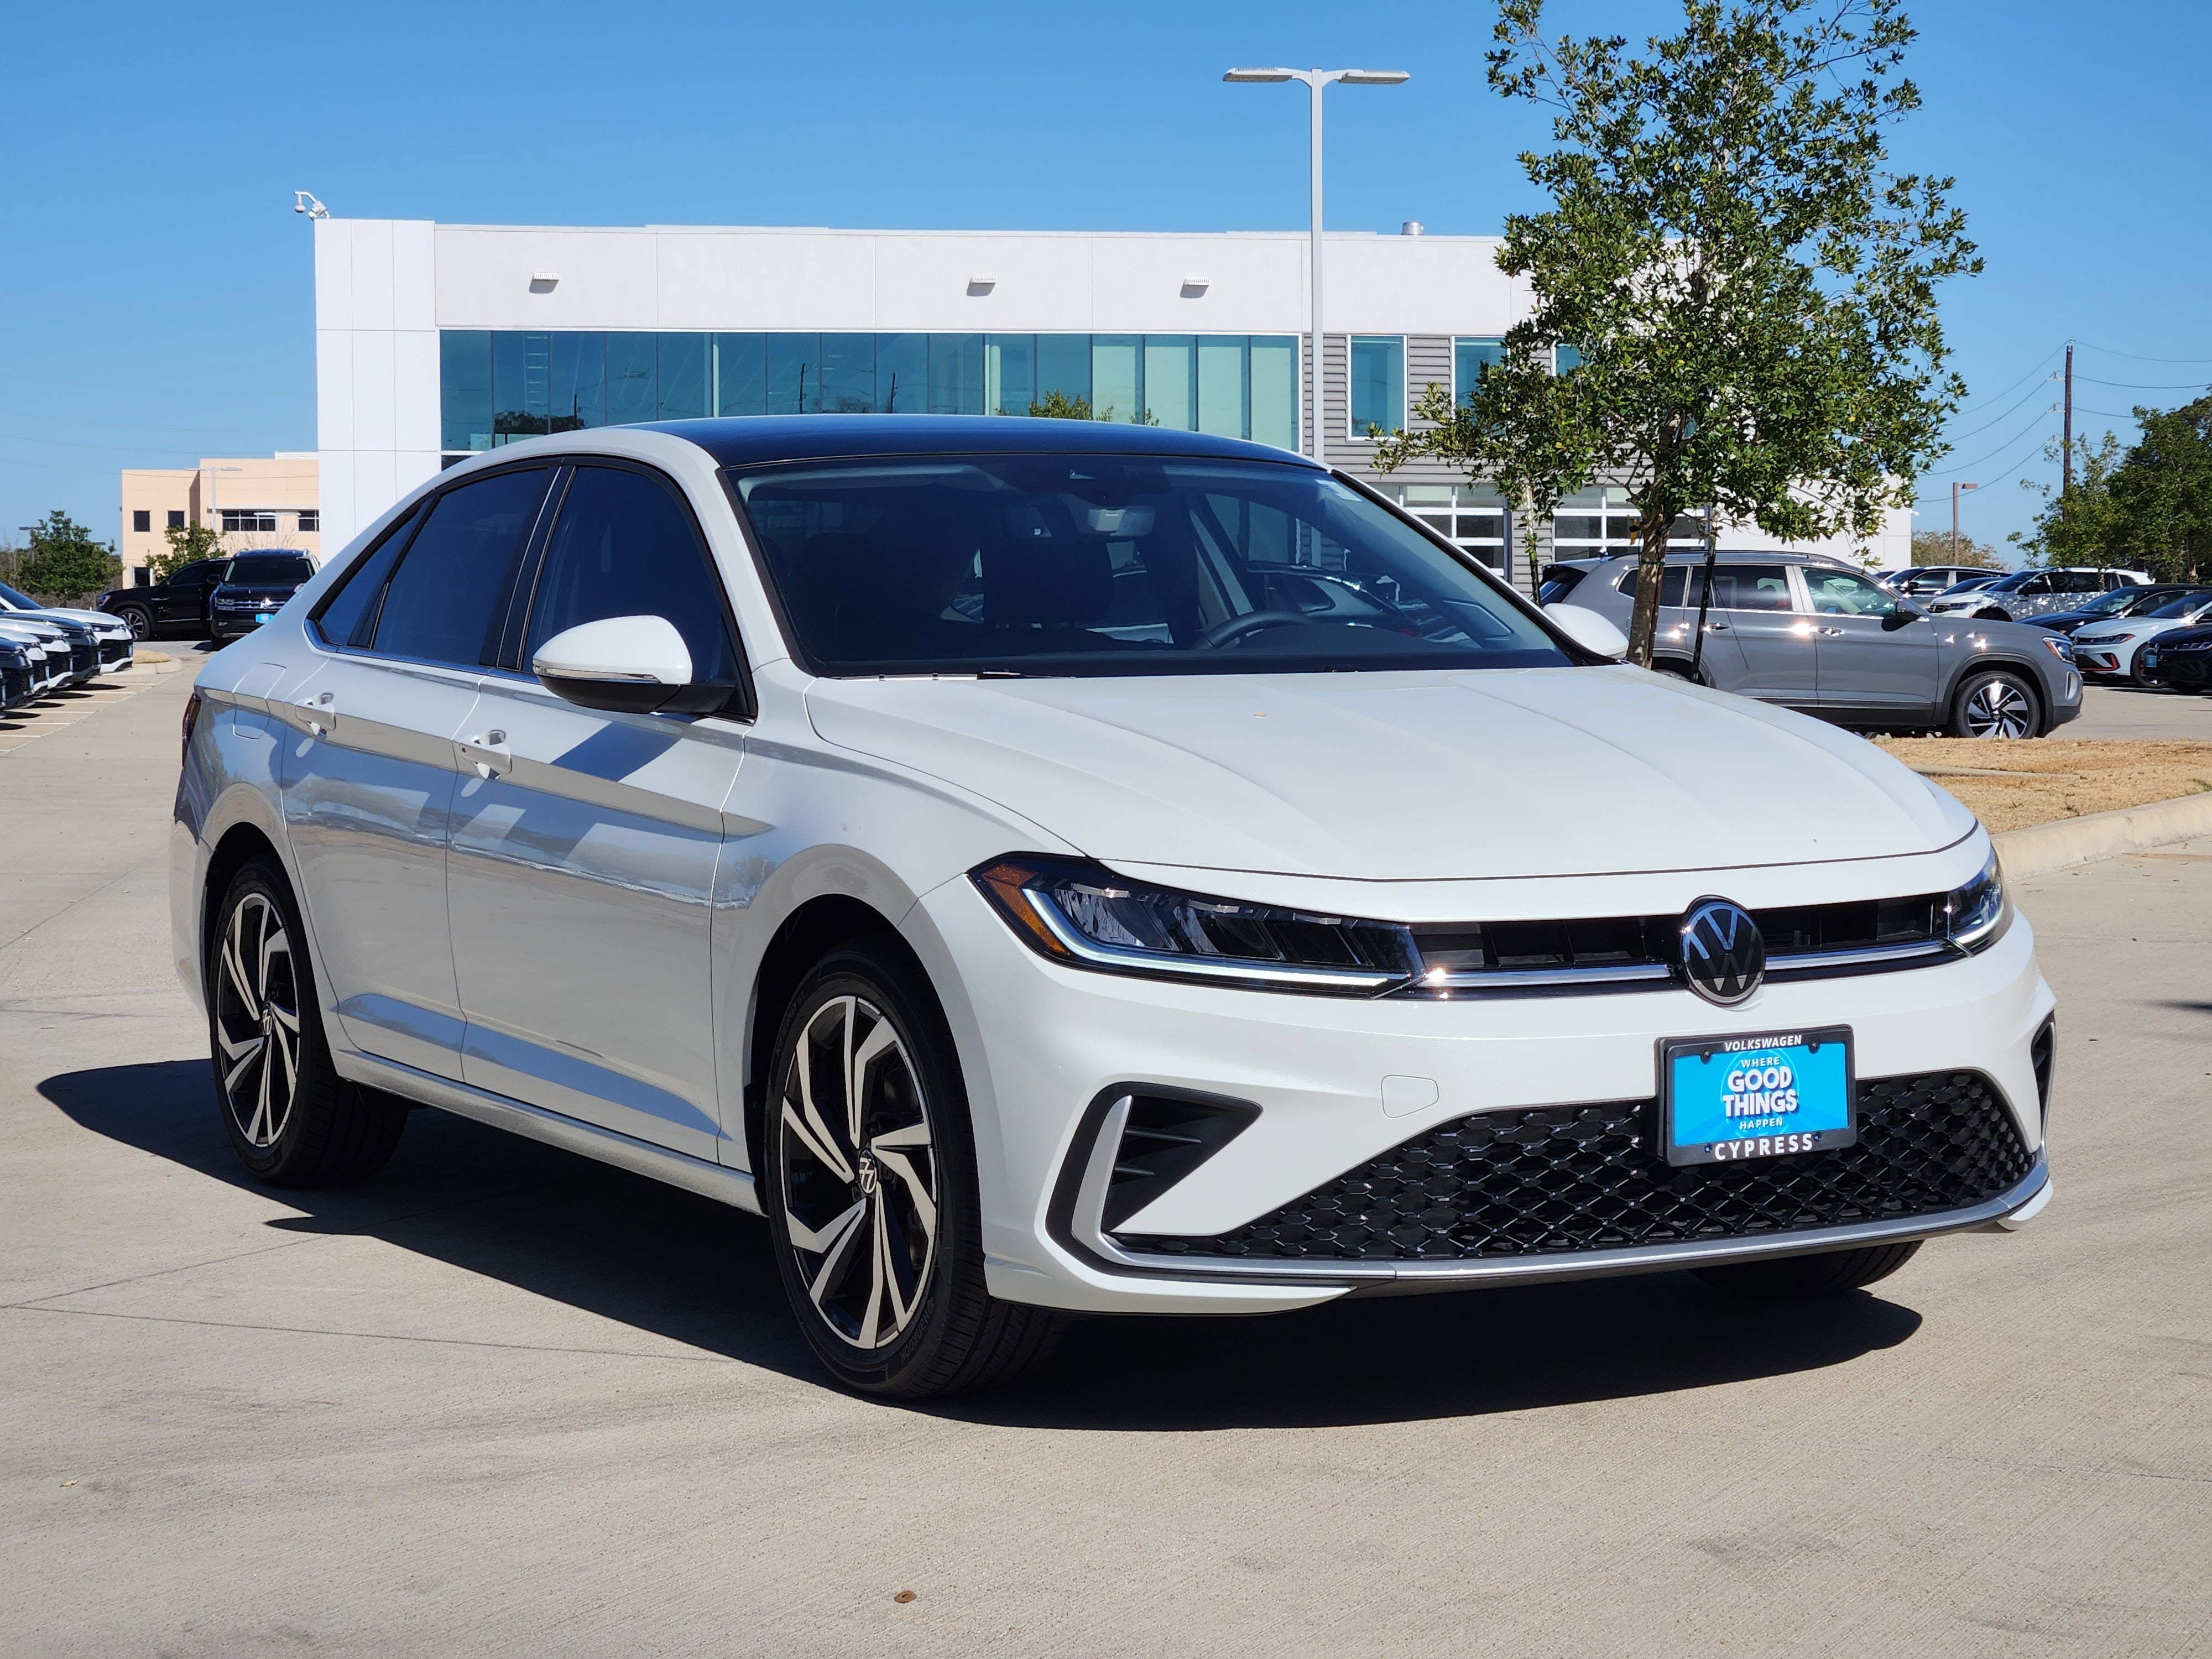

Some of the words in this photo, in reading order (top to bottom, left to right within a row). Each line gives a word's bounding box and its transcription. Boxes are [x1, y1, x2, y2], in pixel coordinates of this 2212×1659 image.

[1725, 1035, 1802, 1052] VOLKSWAGEN
[1741, 1056, 1781, 1068] WHERE
[1727, 1066, 1793, 1093] GOOD
[1722, 1088, 1798, 1118] THINGS
[1739, 1118, 1783, 1130] HAPPEN
[1715, 1133, 1813, 1161] CYPRESS
